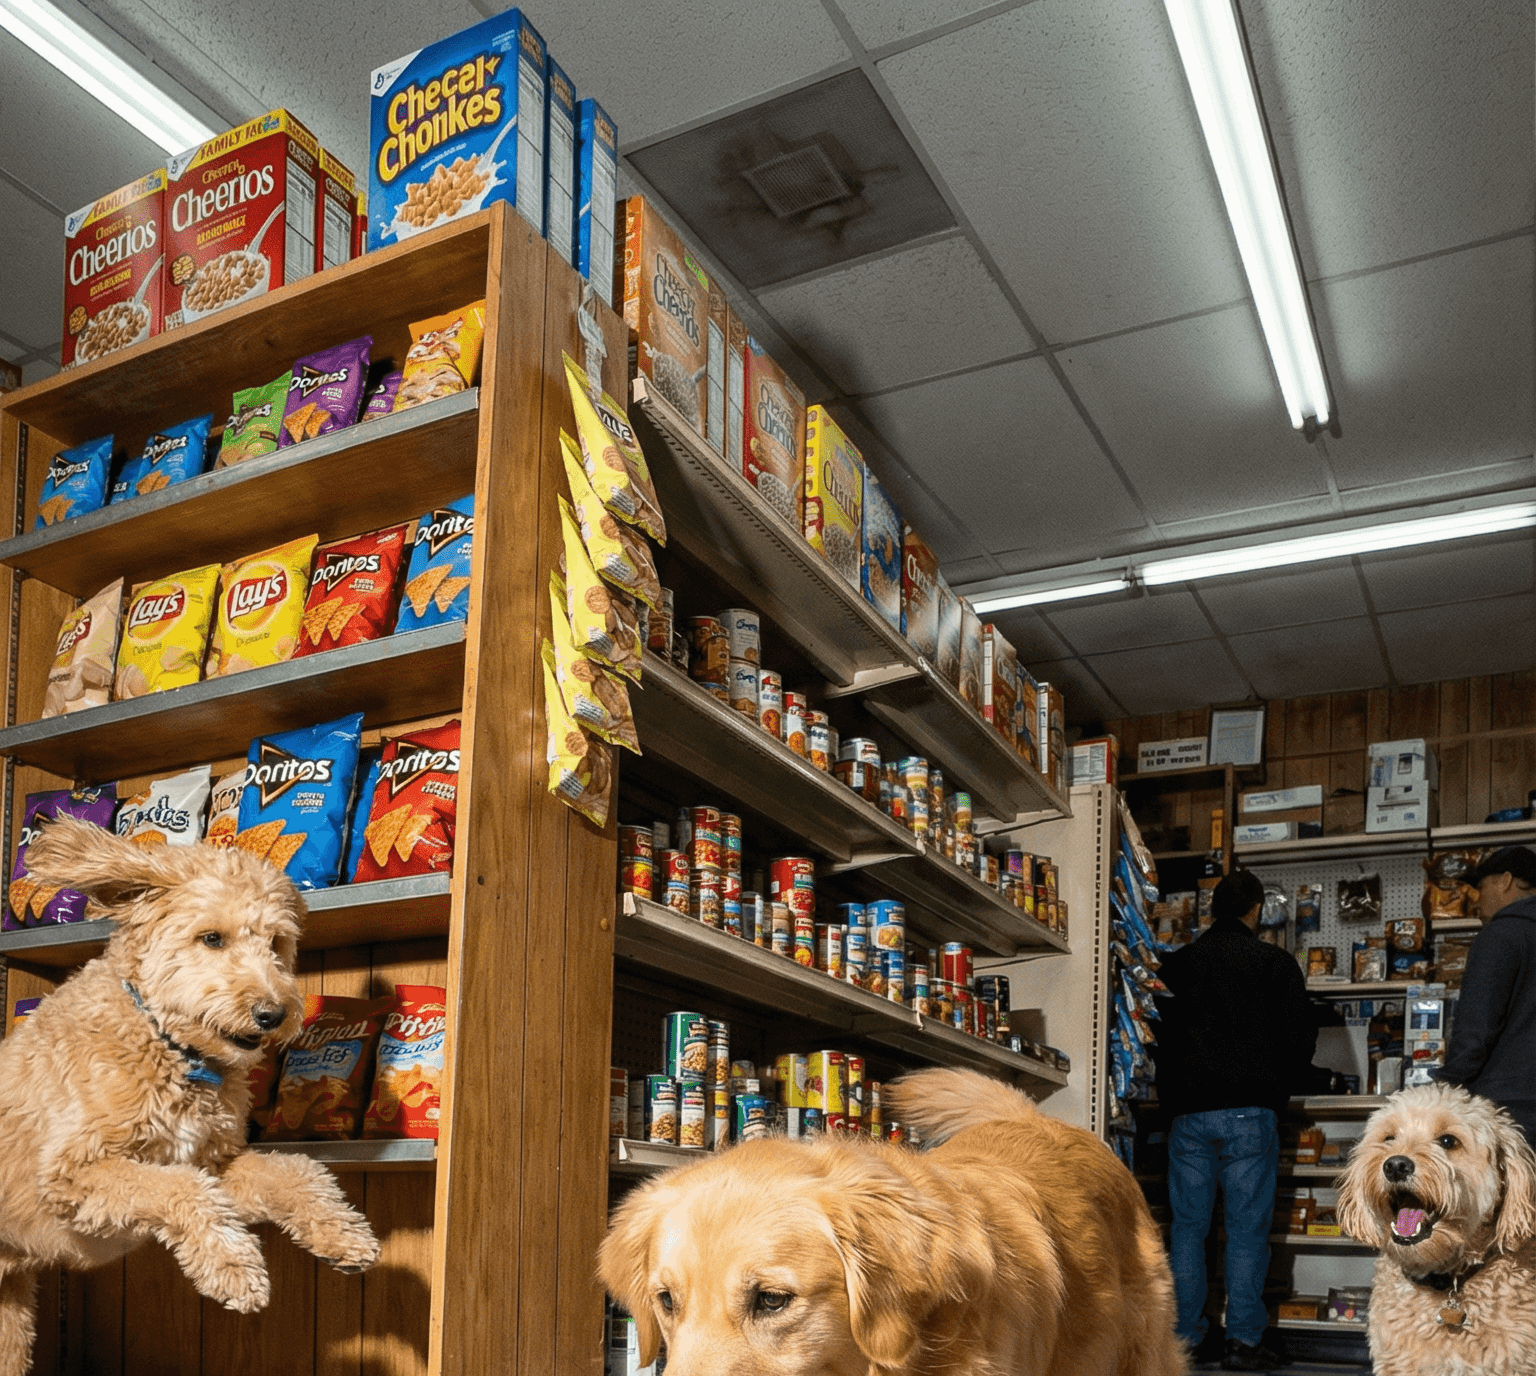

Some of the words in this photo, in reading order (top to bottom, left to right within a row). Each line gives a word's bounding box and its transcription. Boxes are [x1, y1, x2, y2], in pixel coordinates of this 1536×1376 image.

[171, 164, 275, 233] Cheerios
[69, 219, 157, 287] Cheerios
[311, 554, 381, 586] Doritos
[243, 759, 332, 786] Doritos
[375, 749, 461, 784] Doritos
